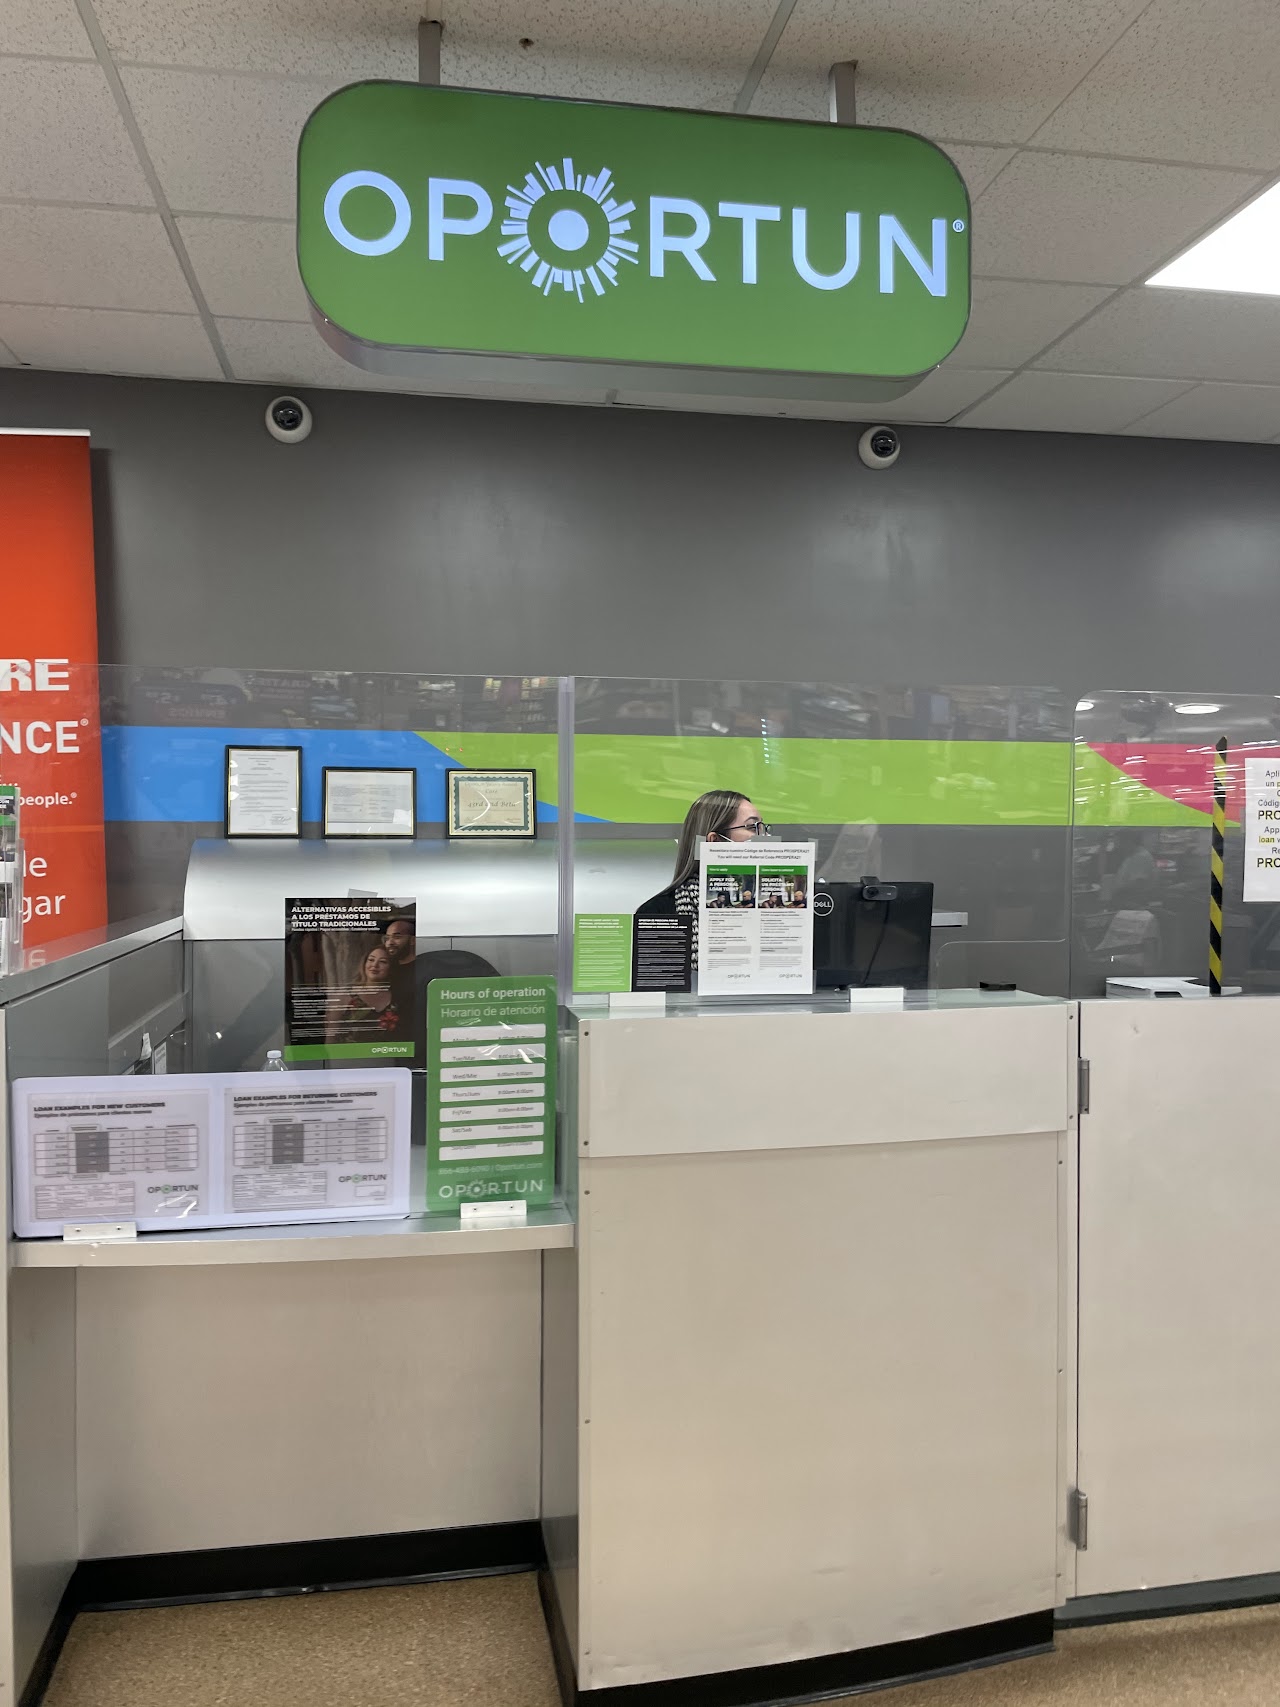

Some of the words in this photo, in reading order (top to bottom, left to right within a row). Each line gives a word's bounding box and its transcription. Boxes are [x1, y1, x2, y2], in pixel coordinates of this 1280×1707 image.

[0, 658, 70, 692] RE
[314, 912, 359, 920] PRÉSTAMOS
[440, 989, 475, 1000] Hours
[477, 988, 490, 999] of
[492, 986, 546, 1000] operation
[440, 1007, 481, 1018] Horario
[483, 1006, 497, 1016] de
[499, 1004, 546, 1016] atención
[371, 1046, 408, 1054] OPORTUN
[338, 1173, 387, 1184] OPORTUN
[147, 1184, 198, 1195] OPORTUN
[438, 1179, 544, 1198] OPORTUN
